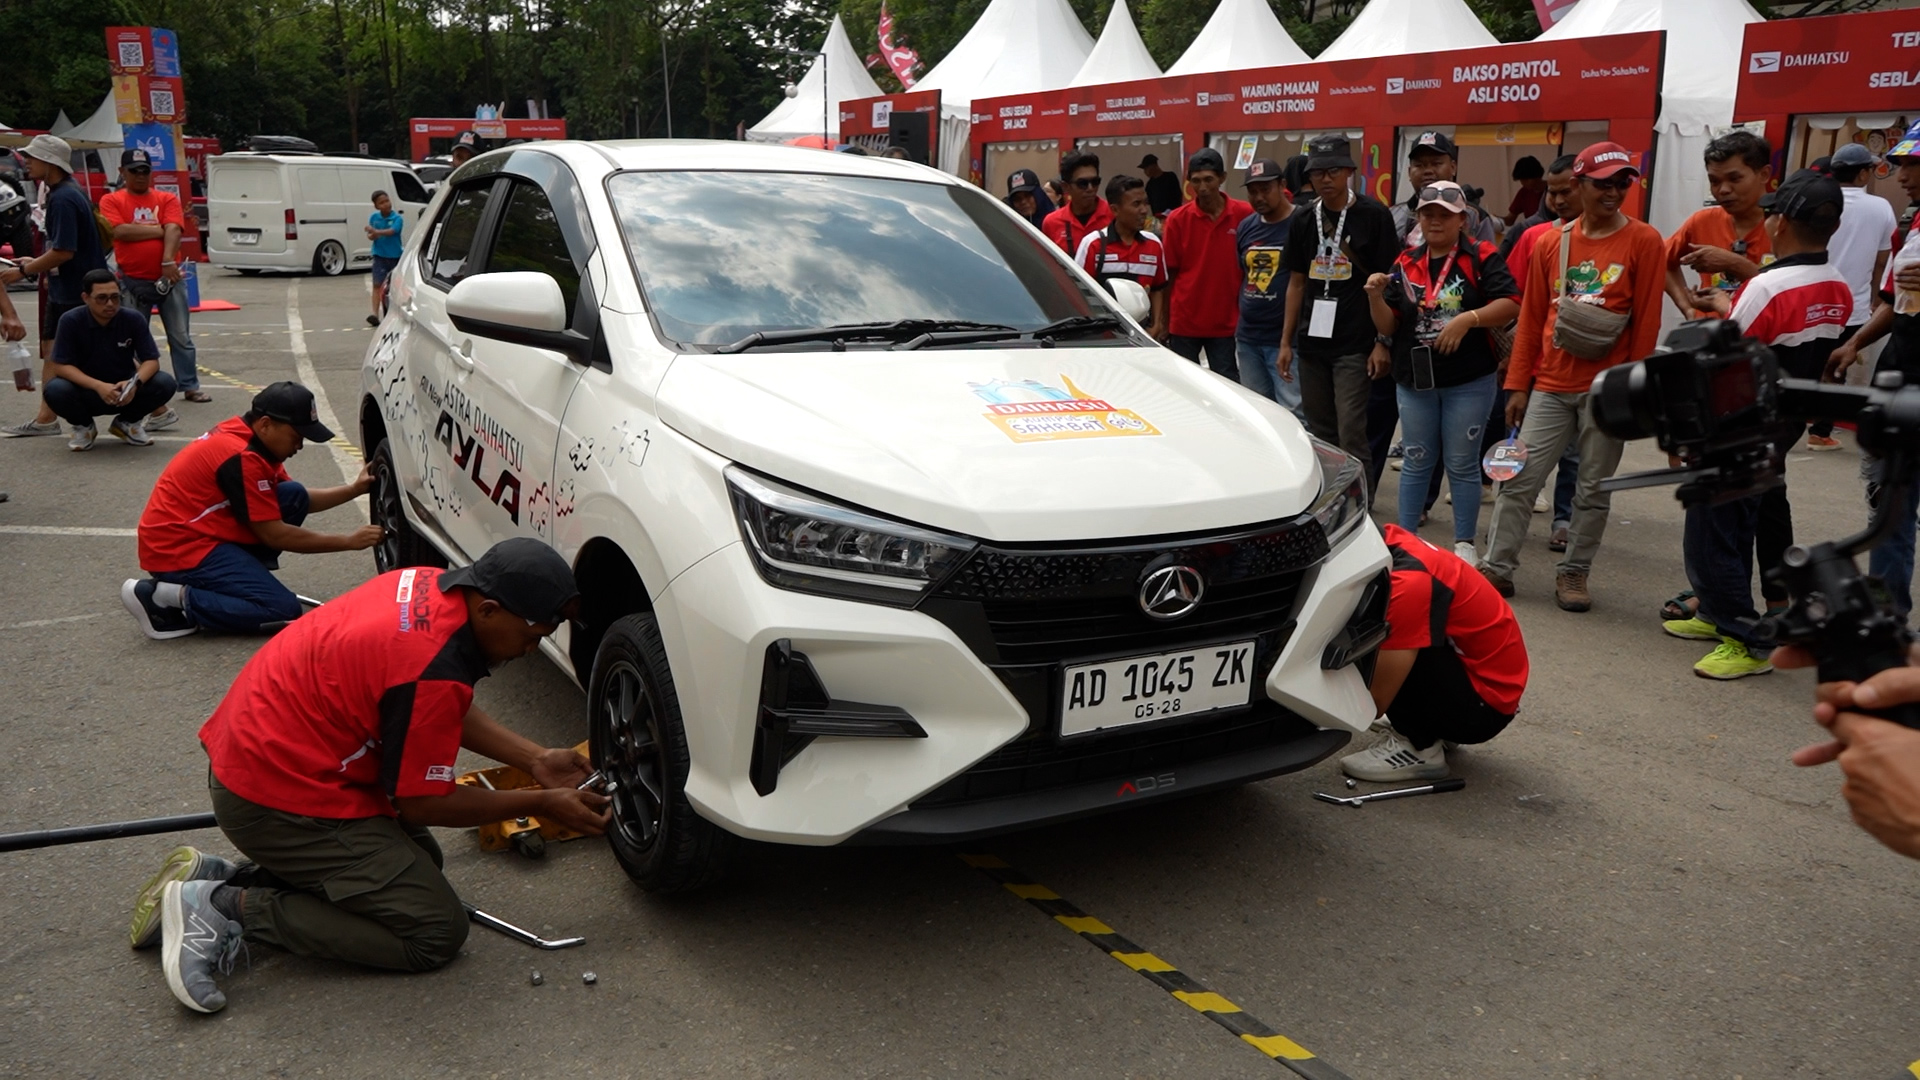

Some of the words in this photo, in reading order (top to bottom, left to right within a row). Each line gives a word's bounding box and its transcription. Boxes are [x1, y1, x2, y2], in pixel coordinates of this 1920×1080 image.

[1784, 51, 1849, 67] DAIHATSU
[1453, 64, 1499, 83] BAKSO
[1501, 59, 1560, 79] PENTOL
[1241, 83, 1282, 98] WARUNG
[1283, 81, 1319, 96] MAKAN
[1405, 78, 1442, 91] DAIHATSU
[1467, 86, 1498, 104] ASLI
[1501, 84, 1540, 102] SOLO
[1242, 101, 1275, 115] CHIKEN
[1276, 99, 1315, 112] STRONG
[419, 375, 429, 394] All
[428, 383, 443, 409] New
[994, 400, 1108, 414] DAIHATSU
[443, 380, 471, 426] ASTRA
[474, 406, 525, 473] DAIHATSU
[1012, 420, 1106, 434] SAHABAT
[434, 409, 521, 527] AYLA
[1068, 668, 1107, 710] AD
[1122, 655, 1195, 702] 1045
[1212, 648, 1249, 687] ZK
